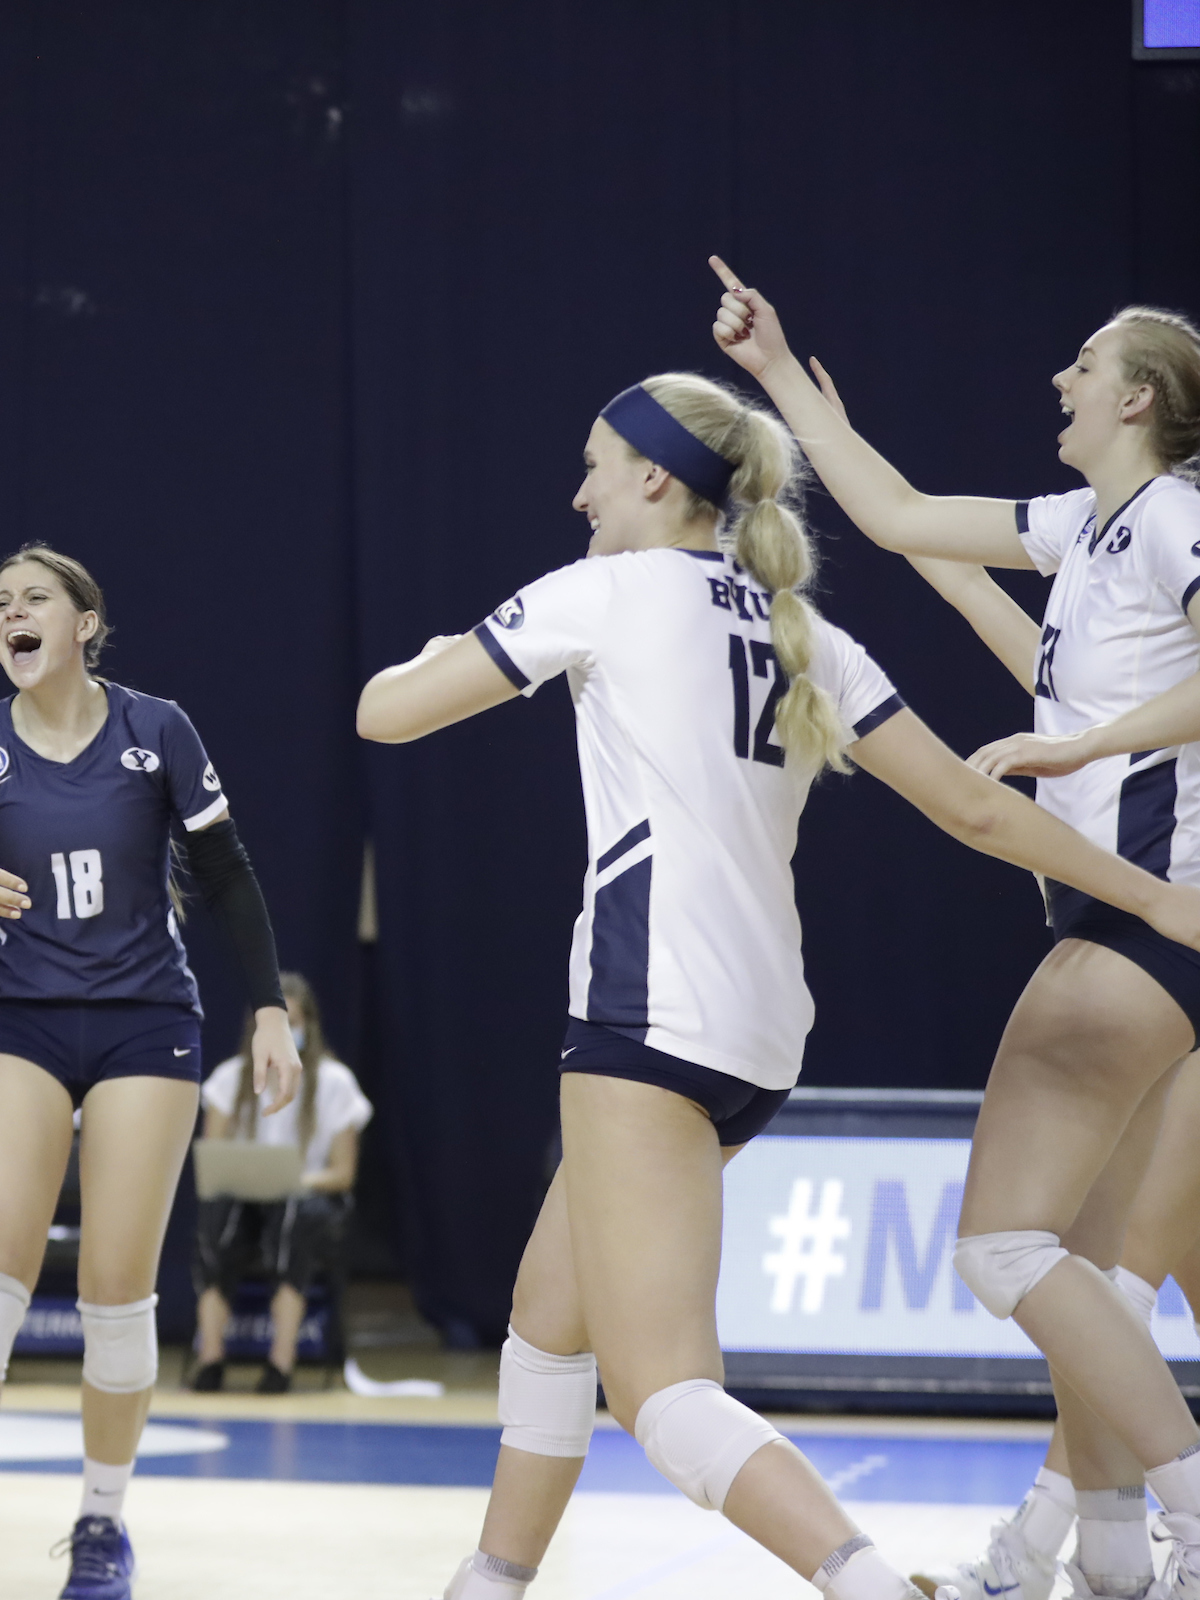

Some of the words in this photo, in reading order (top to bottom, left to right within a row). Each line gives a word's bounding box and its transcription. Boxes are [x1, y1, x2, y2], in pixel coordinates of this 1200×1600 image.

[706, 575, 774, 622] BYU
[729, 633, 791, 768] 12
[128, 749, 152, 771] Y
[51, 849, 104, 920] 18
